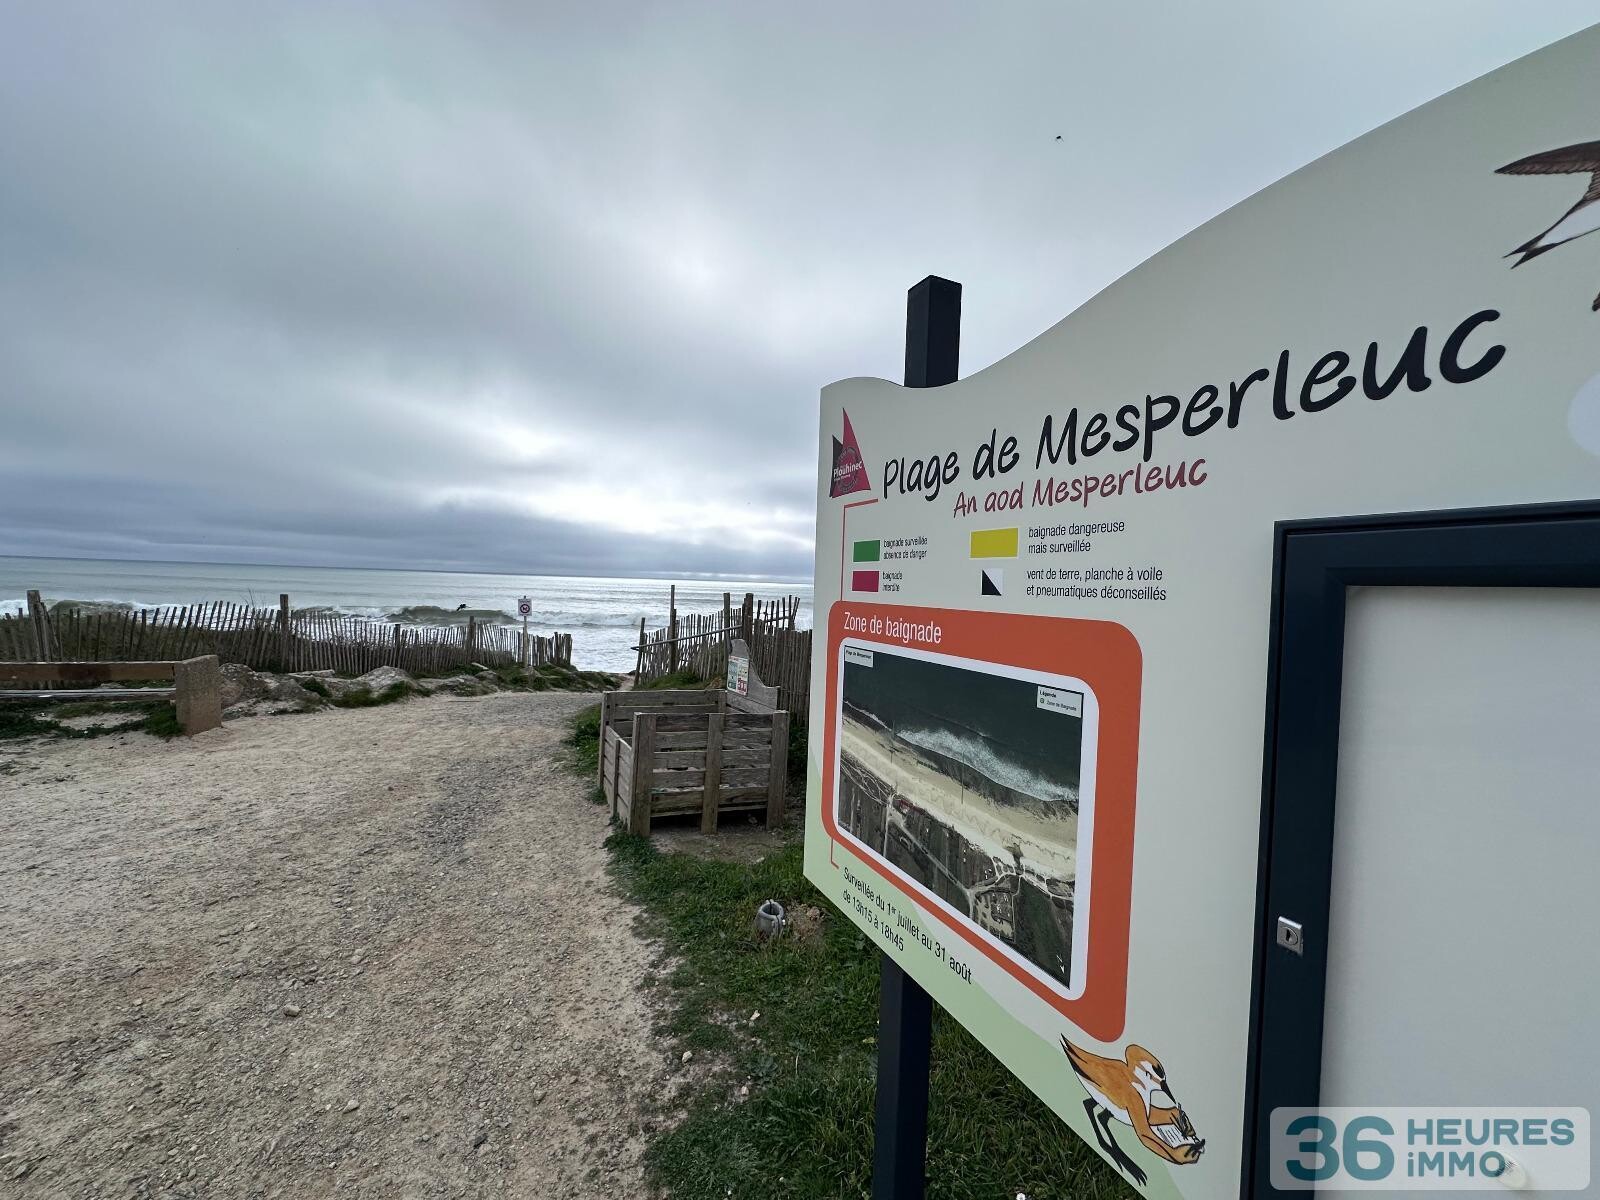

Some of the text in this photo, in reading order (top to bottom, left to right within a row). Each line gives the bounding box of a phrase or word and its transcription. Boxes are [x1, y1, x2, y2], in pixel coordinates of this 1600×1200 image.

[883, 309, 1506, 502] Plage de Mesperleuc
[953, 458, 1208, 519] An aod Mesperleuc
[1028, 520, 1125, 541] baignade dangereuse
[1028, 539, 1091, 554] mais surveillée
[1026, 566, 1163, 583] vent de terre, planche à voile
[1026, 584, 1168, 601] et pneumatiques déconseillés
[843, 611, 943, 645] Zone de baignade
[843, 867, 875, 902] Surveillée
[875, 895, 885, 913] du
[897, 911, 920, 941] juillet
[921, 933, 932, 951] au
[934, 941, 946, 962] 31
[949, 956, 972, 985] août
[873, 914, 879, 930] à
[880, 921, 904, 952] 18h45
